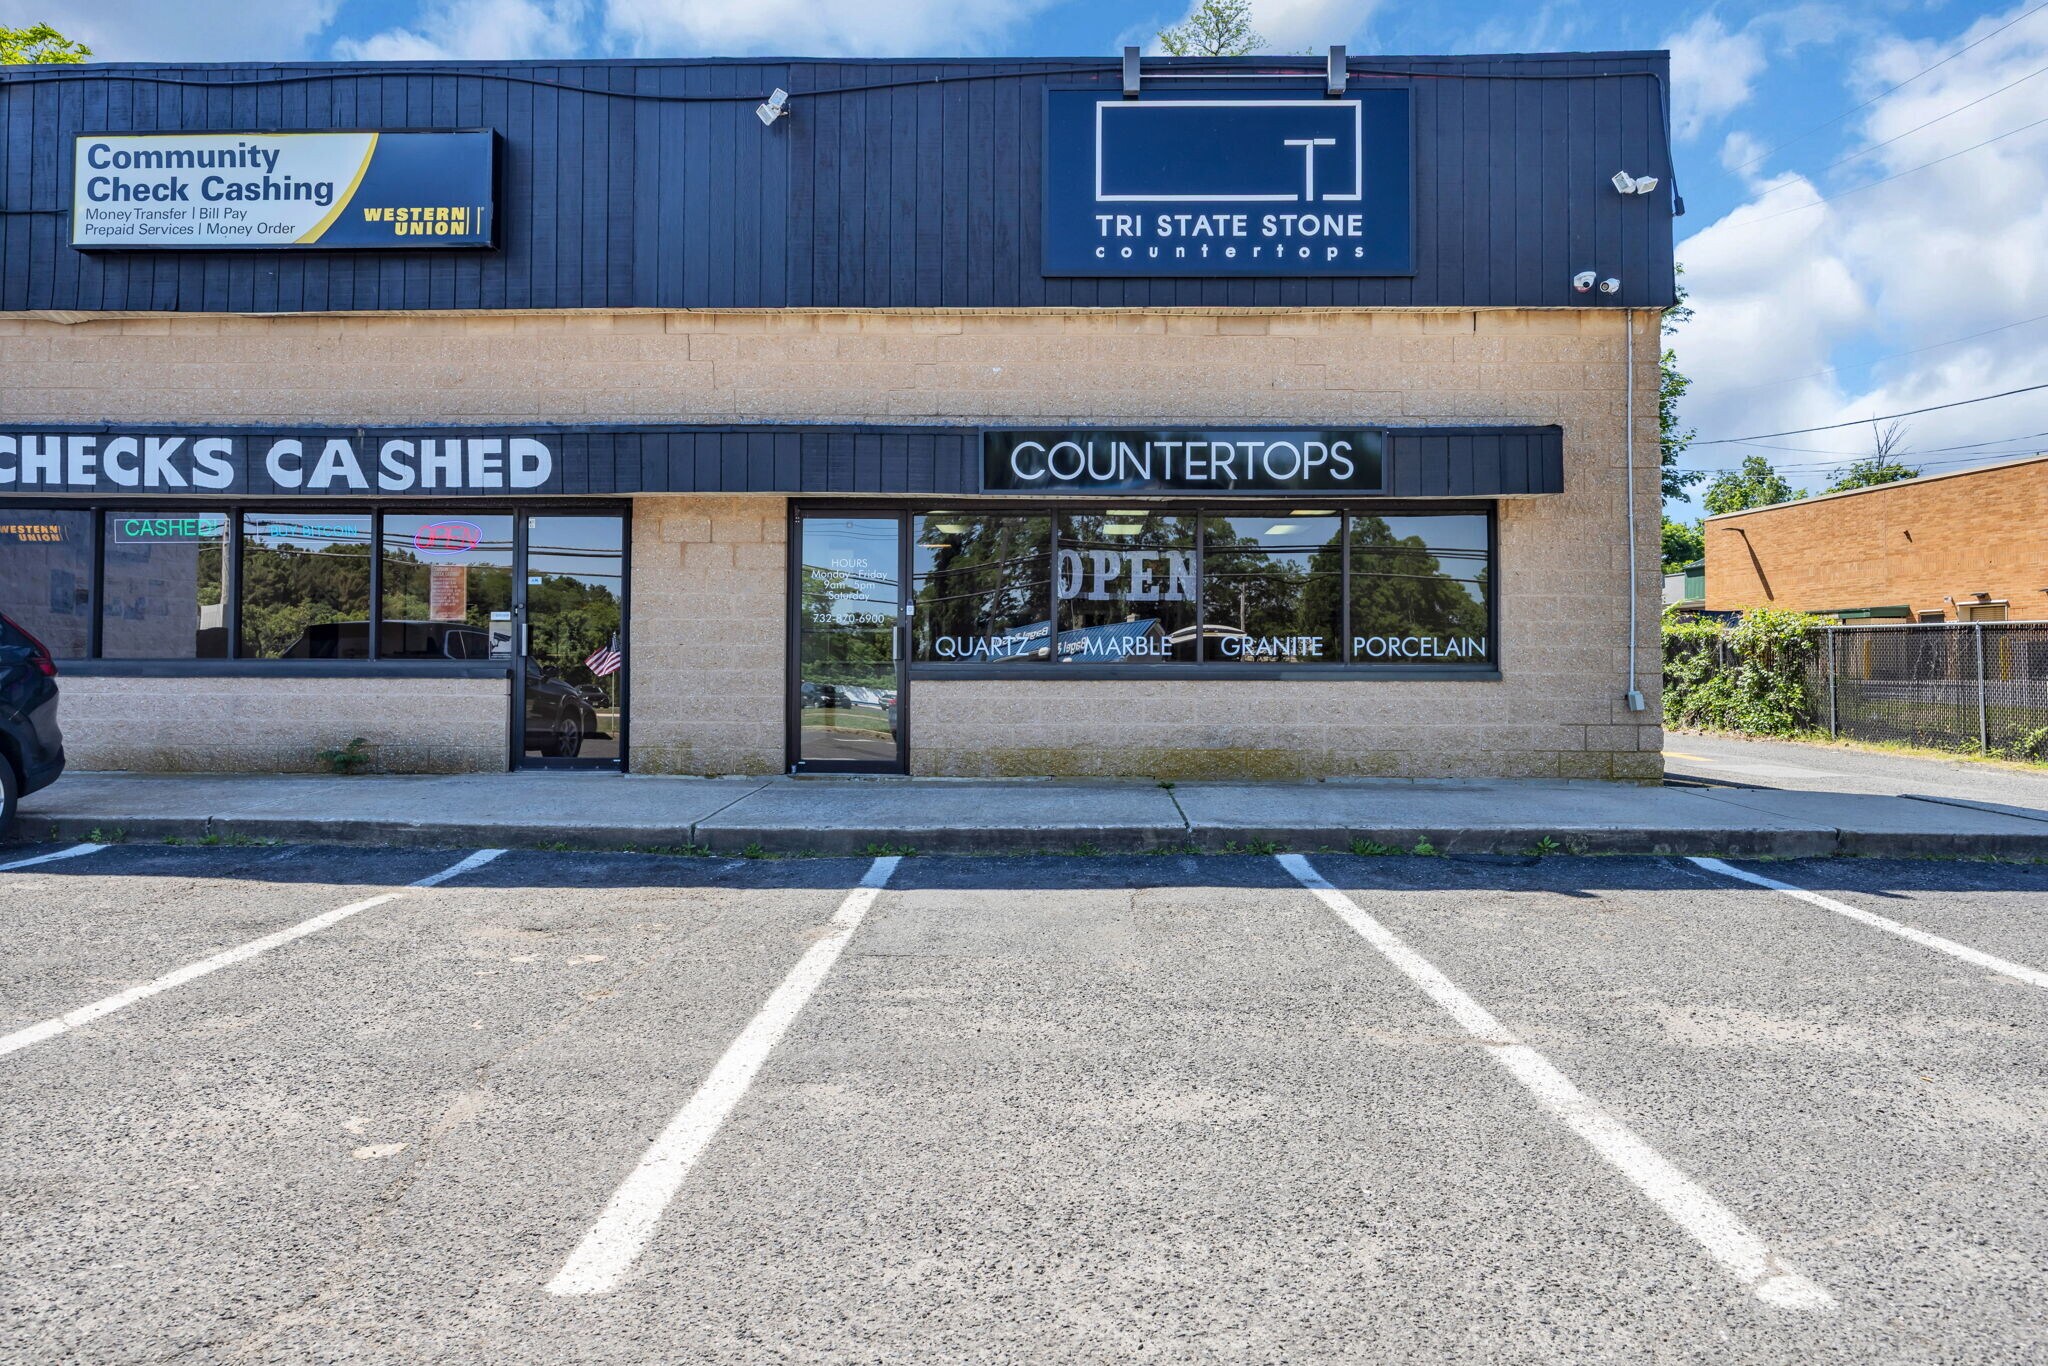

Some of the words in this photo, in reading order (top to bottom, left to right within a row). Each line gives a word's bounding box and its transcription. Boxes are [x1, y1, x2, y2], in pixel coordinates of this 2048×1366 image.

[87, 142, 280, 174] Community
[86, 176, 190, 202] Check
[201, 175, 334, 207] Cashing
[85, 208, 133, 223] Money
[134, 207, 187, 220] Transfer
[200, 207, 220, 219] Bill
[224, 208, 248, 222] Pay
[363, 207, 465, 222] WESTERN
[85, 223, 135, 236] Prepaid
[138, 223, 194, 236] Services
[206, 222, 253, 237] Money
[257, 222, 296, 235] Order
[395, 221, 465, 236] UNION
[1096, 215, 1142, 236] TRI
[1157, 214, 1248, 237] STATE
[1262, 214, 1363, 237] STONE
[1096, 243, 1364, 261] countertops
[265, 438, 552, 491] CASHED
[1010, 440, 1355, 481] COUNTERTOPS
[0, 525, 58, 534] WESTERN
[19, 533, 60, 542] UNION
[271, 525, 297, 536] BUY
[303, 525, 357, 536] BITCOIN
[417, 525, 479, 549] OPEN
[831, 558, 868, 568] HOURS
[811, 570, 851, 580] Monday
[858, 569, 888, 580] Friday
[1057, 549, 1197, 600] OPEN
[824, 580, 845, 590] 9am
[854, 581, 875, 591] 5pm
[828, 590, 870, 602] Saturday
[812, 613, 885, 624] 732-870-6900
[935, 636, 1029, 657] QUARTZ
[1083, 636, 1172, 656] MARBLE
[1221, 636, 1324, 657] GRANITE
[1353, 636, 1486, 657] PORCELAIN
